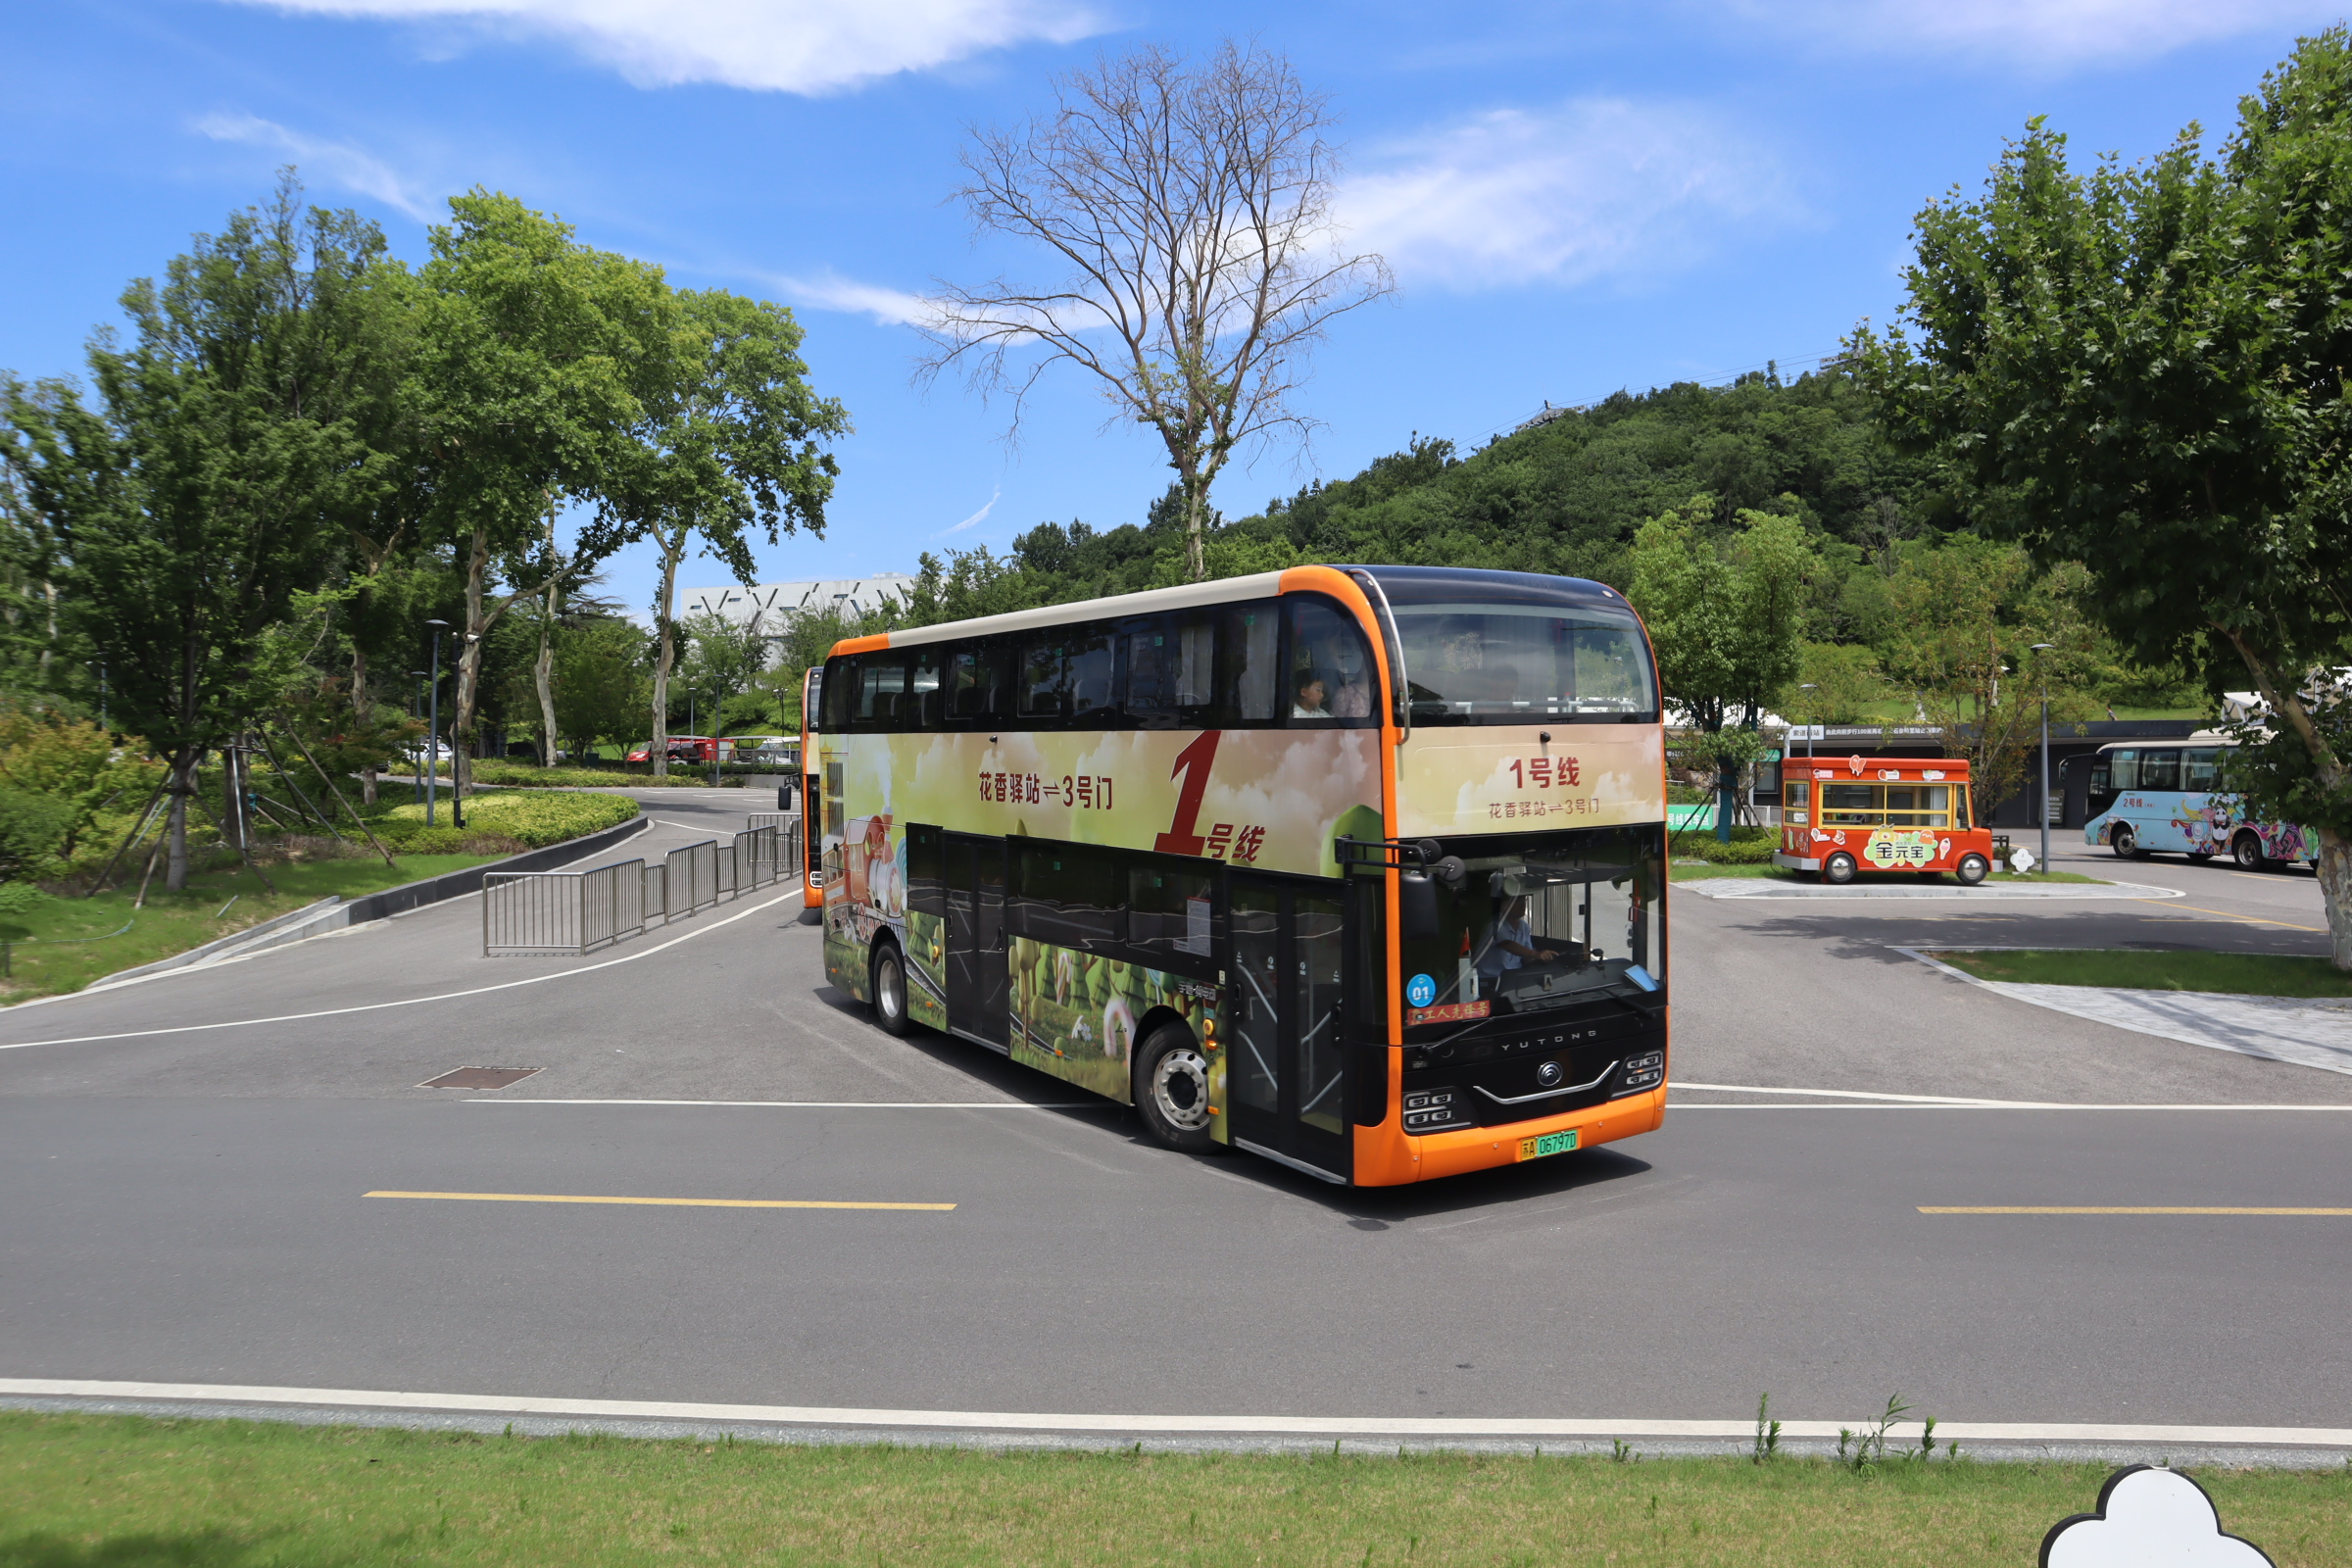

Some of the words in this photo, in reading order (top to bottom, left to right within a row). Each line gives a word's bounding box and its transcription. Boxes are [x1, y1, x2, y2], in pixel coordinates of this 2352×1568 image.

[1509, 757, 1581, 789] 1号线
[2123, 798, 2143, 808] 2号线
[1876, 842, 1923, 858] 金元宝
[1412, 986, 1429, 1001] 01
[1501, 1030, 1596, 1051] YUTONG
